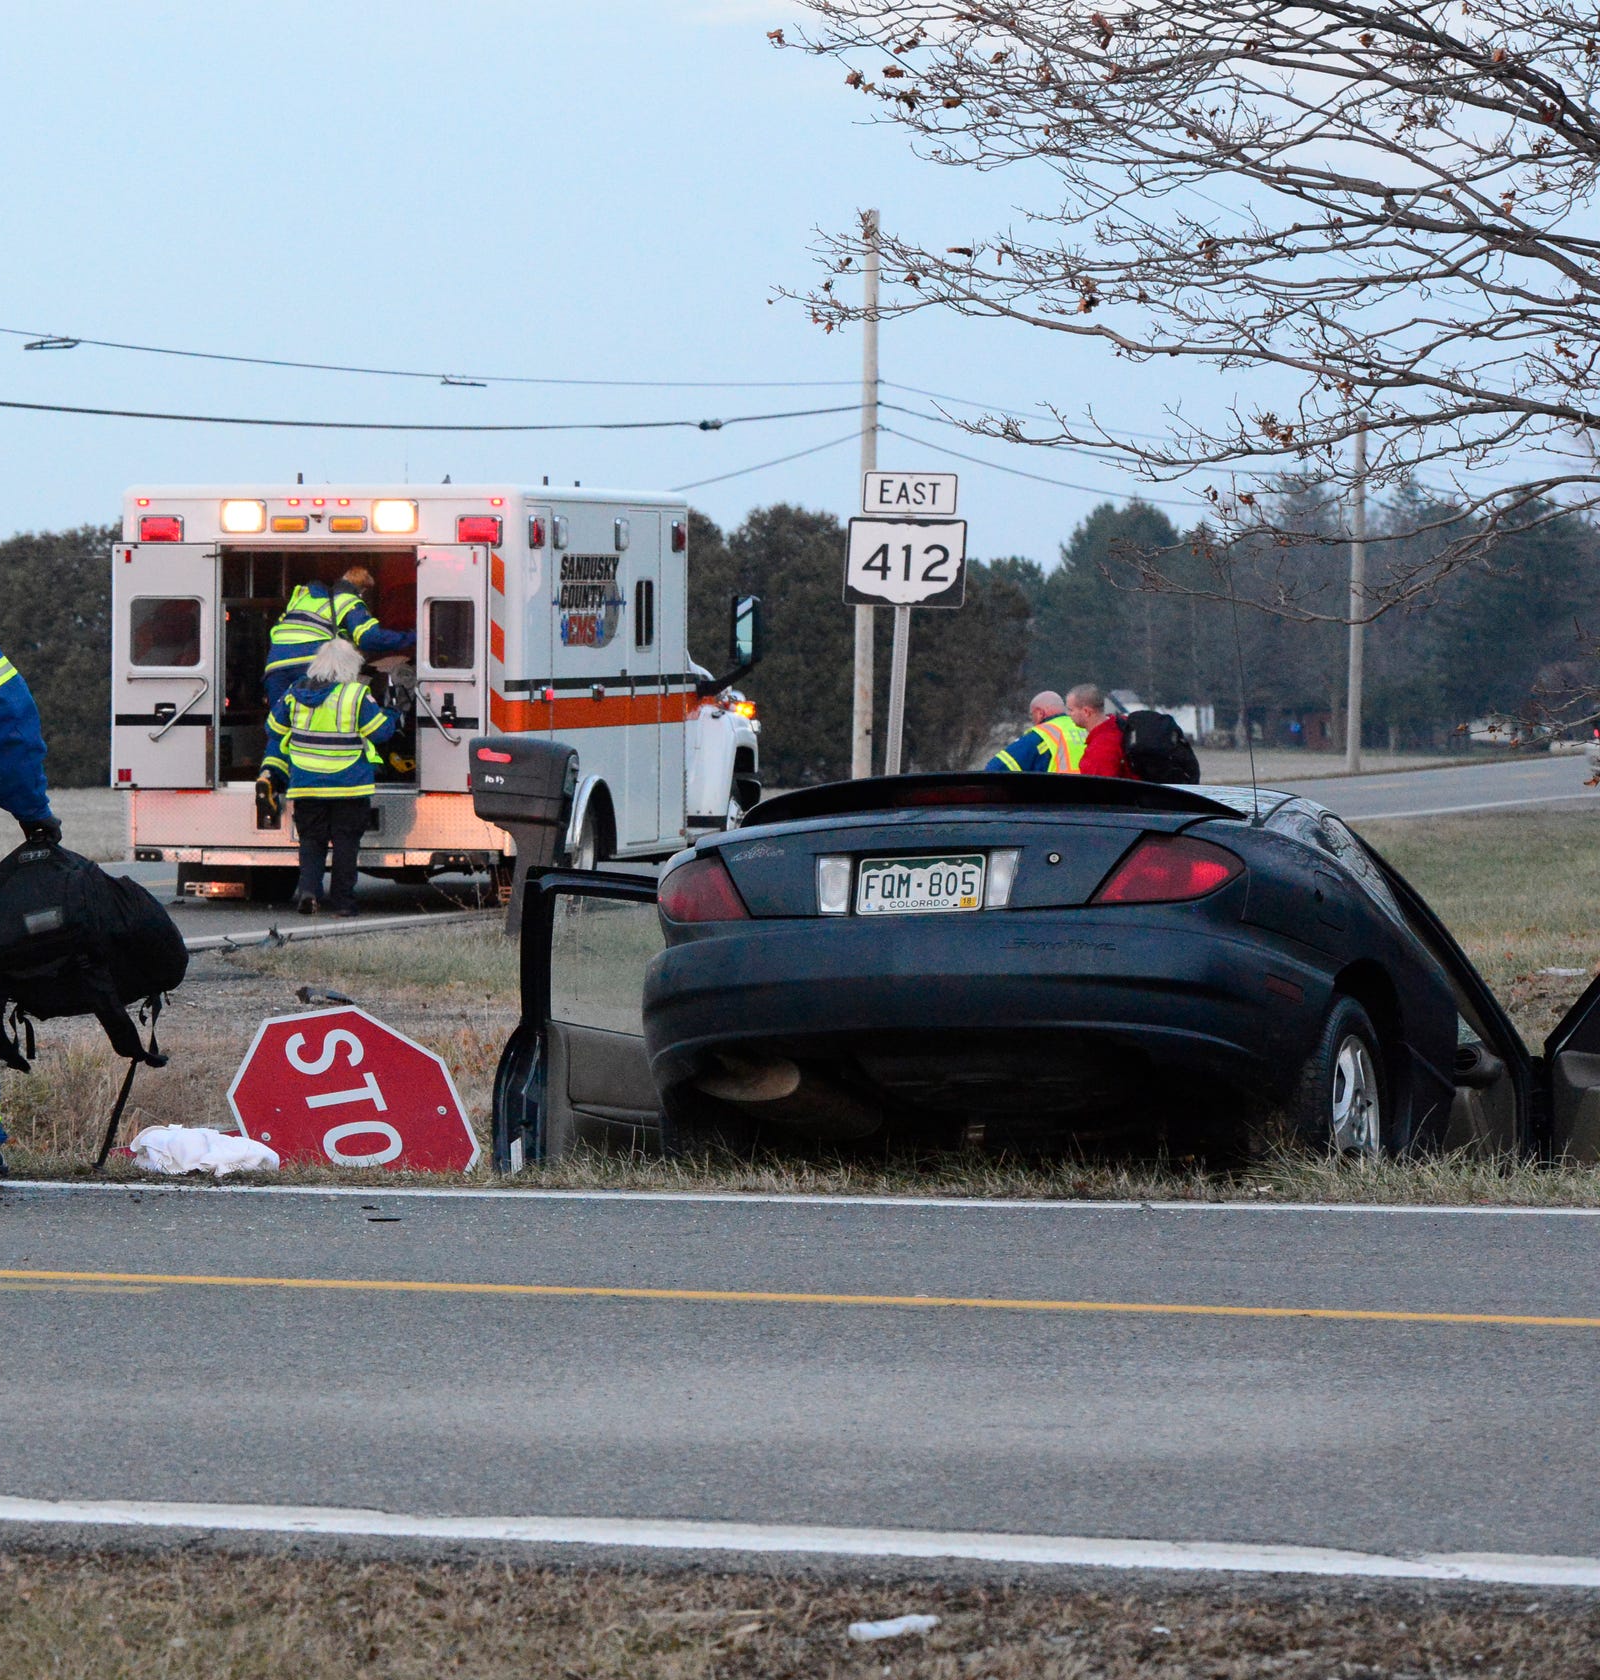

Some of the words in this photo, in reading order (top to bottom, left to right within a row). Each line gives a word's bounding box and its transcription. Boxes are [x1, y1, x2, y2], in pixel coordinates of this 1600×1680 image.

[878, 479, 941, 505] EAST
[560, 554, 619, 581] SANDUSKY
[862, 543, 950, 582] 412
[560, 584, 606, 609] COUNTY
[567, 614, 598, 645] EMS
[889, 899, 950, 909] COLORADO
[285, 1028, 404, 1168] STO
